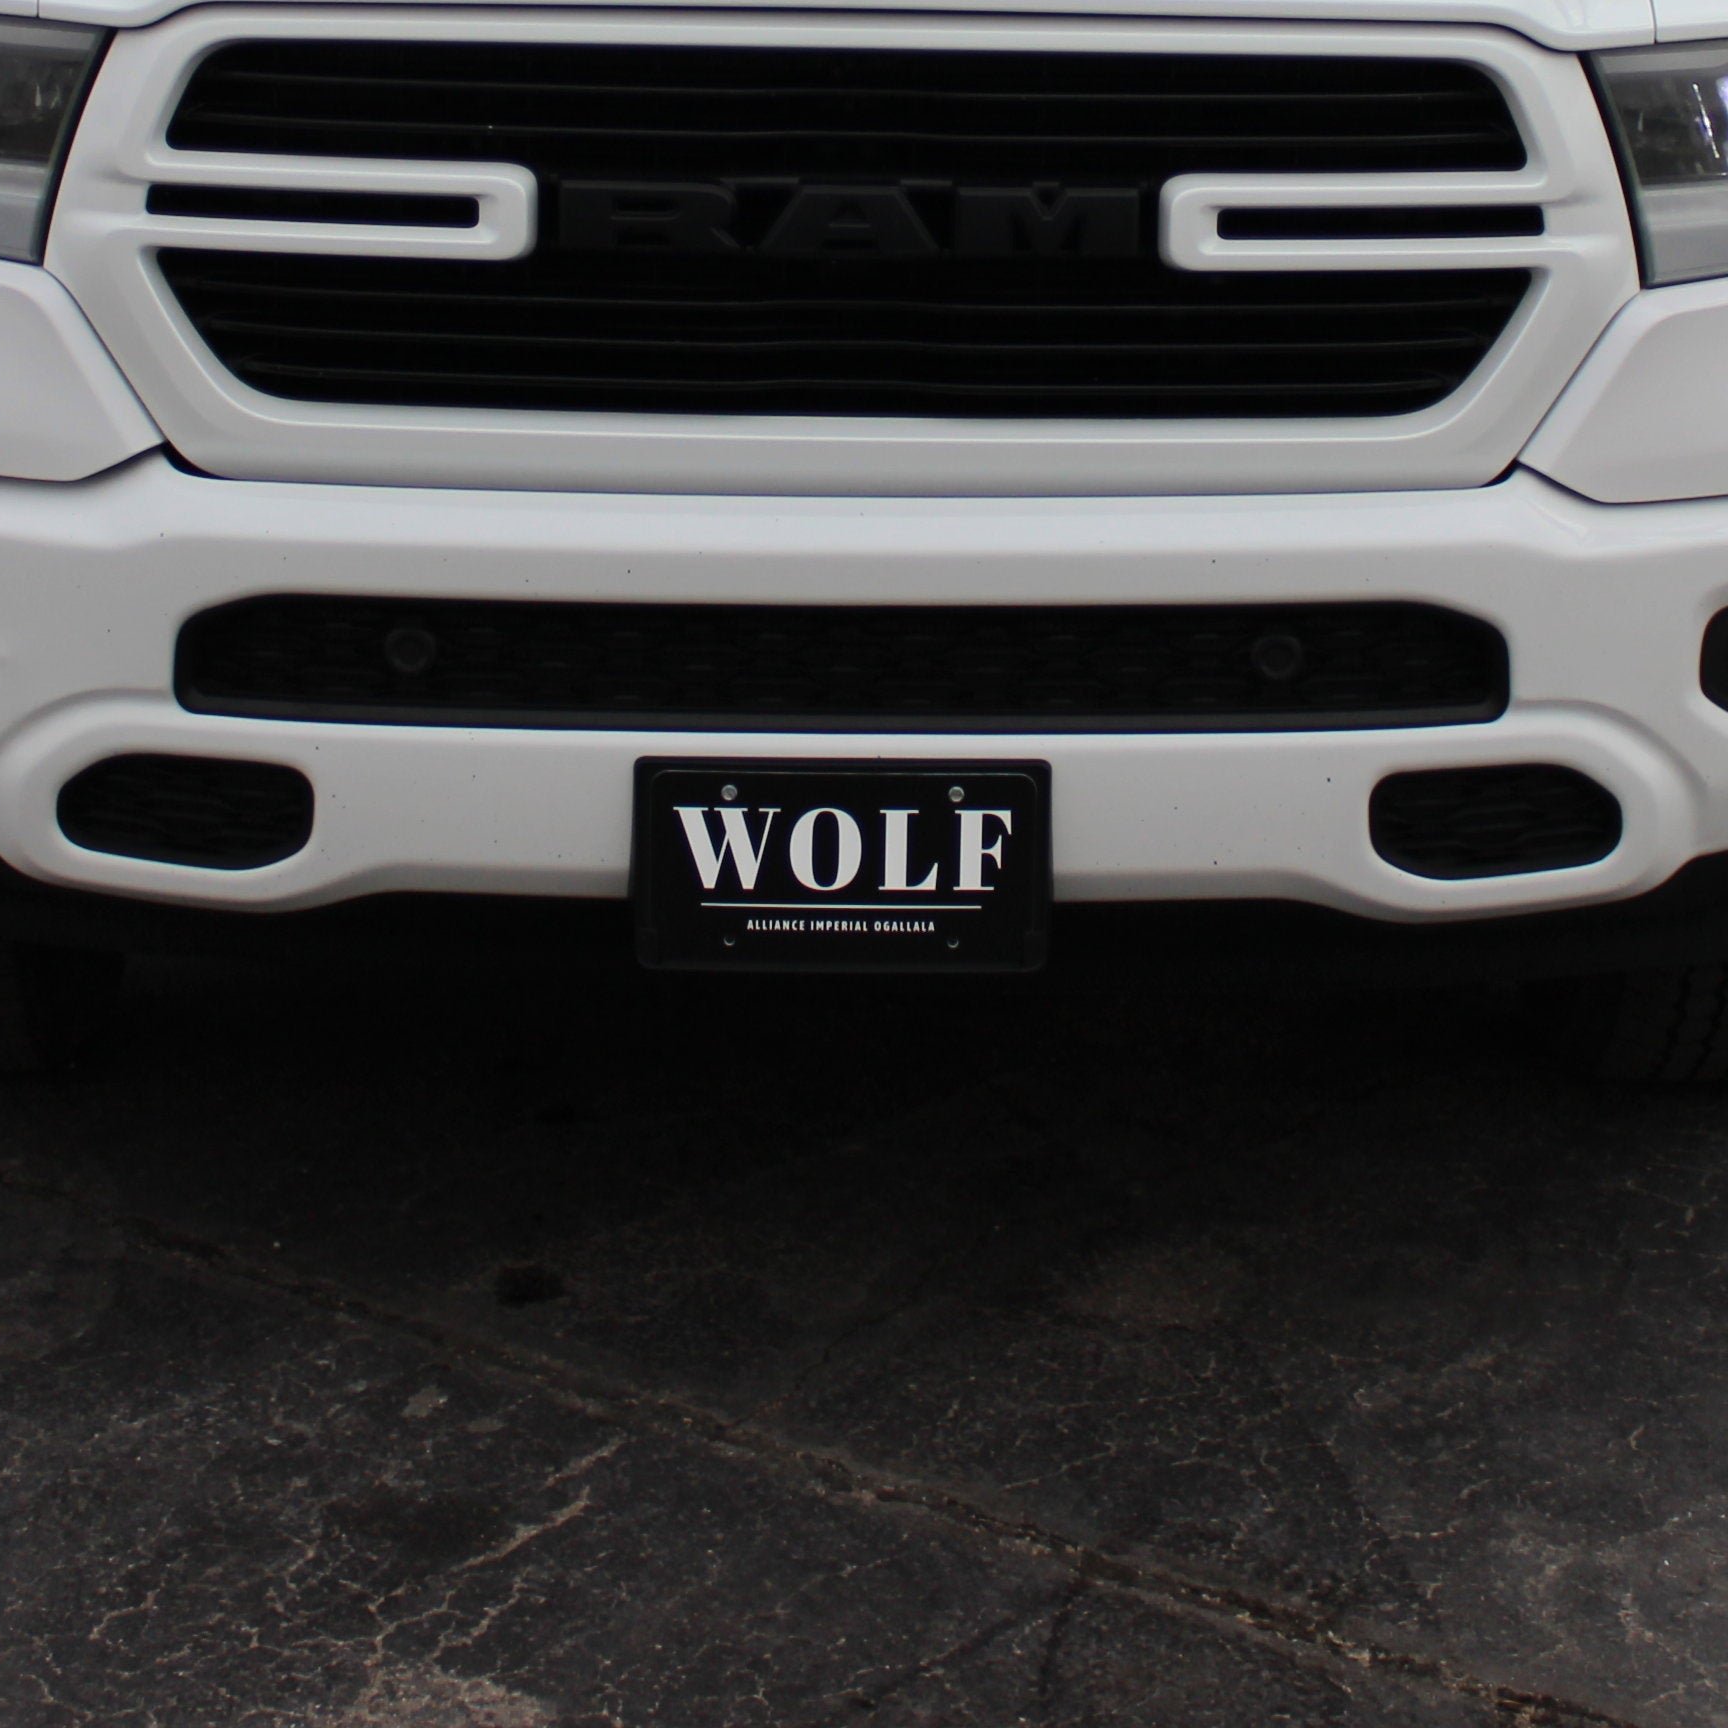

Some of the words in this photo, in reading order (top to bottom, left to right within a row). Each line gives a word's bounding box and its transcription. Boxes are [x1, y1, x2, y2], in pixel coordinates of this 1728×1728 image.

[559, 179, 1139, 255] RAM
[672, 805, 1013, 892] WOLF
[746, 919, 805, 931] ALLIANCE
[810, 920, 869, 932] IMPERIAL
[874, 920, 935, 933] OGALLALA
